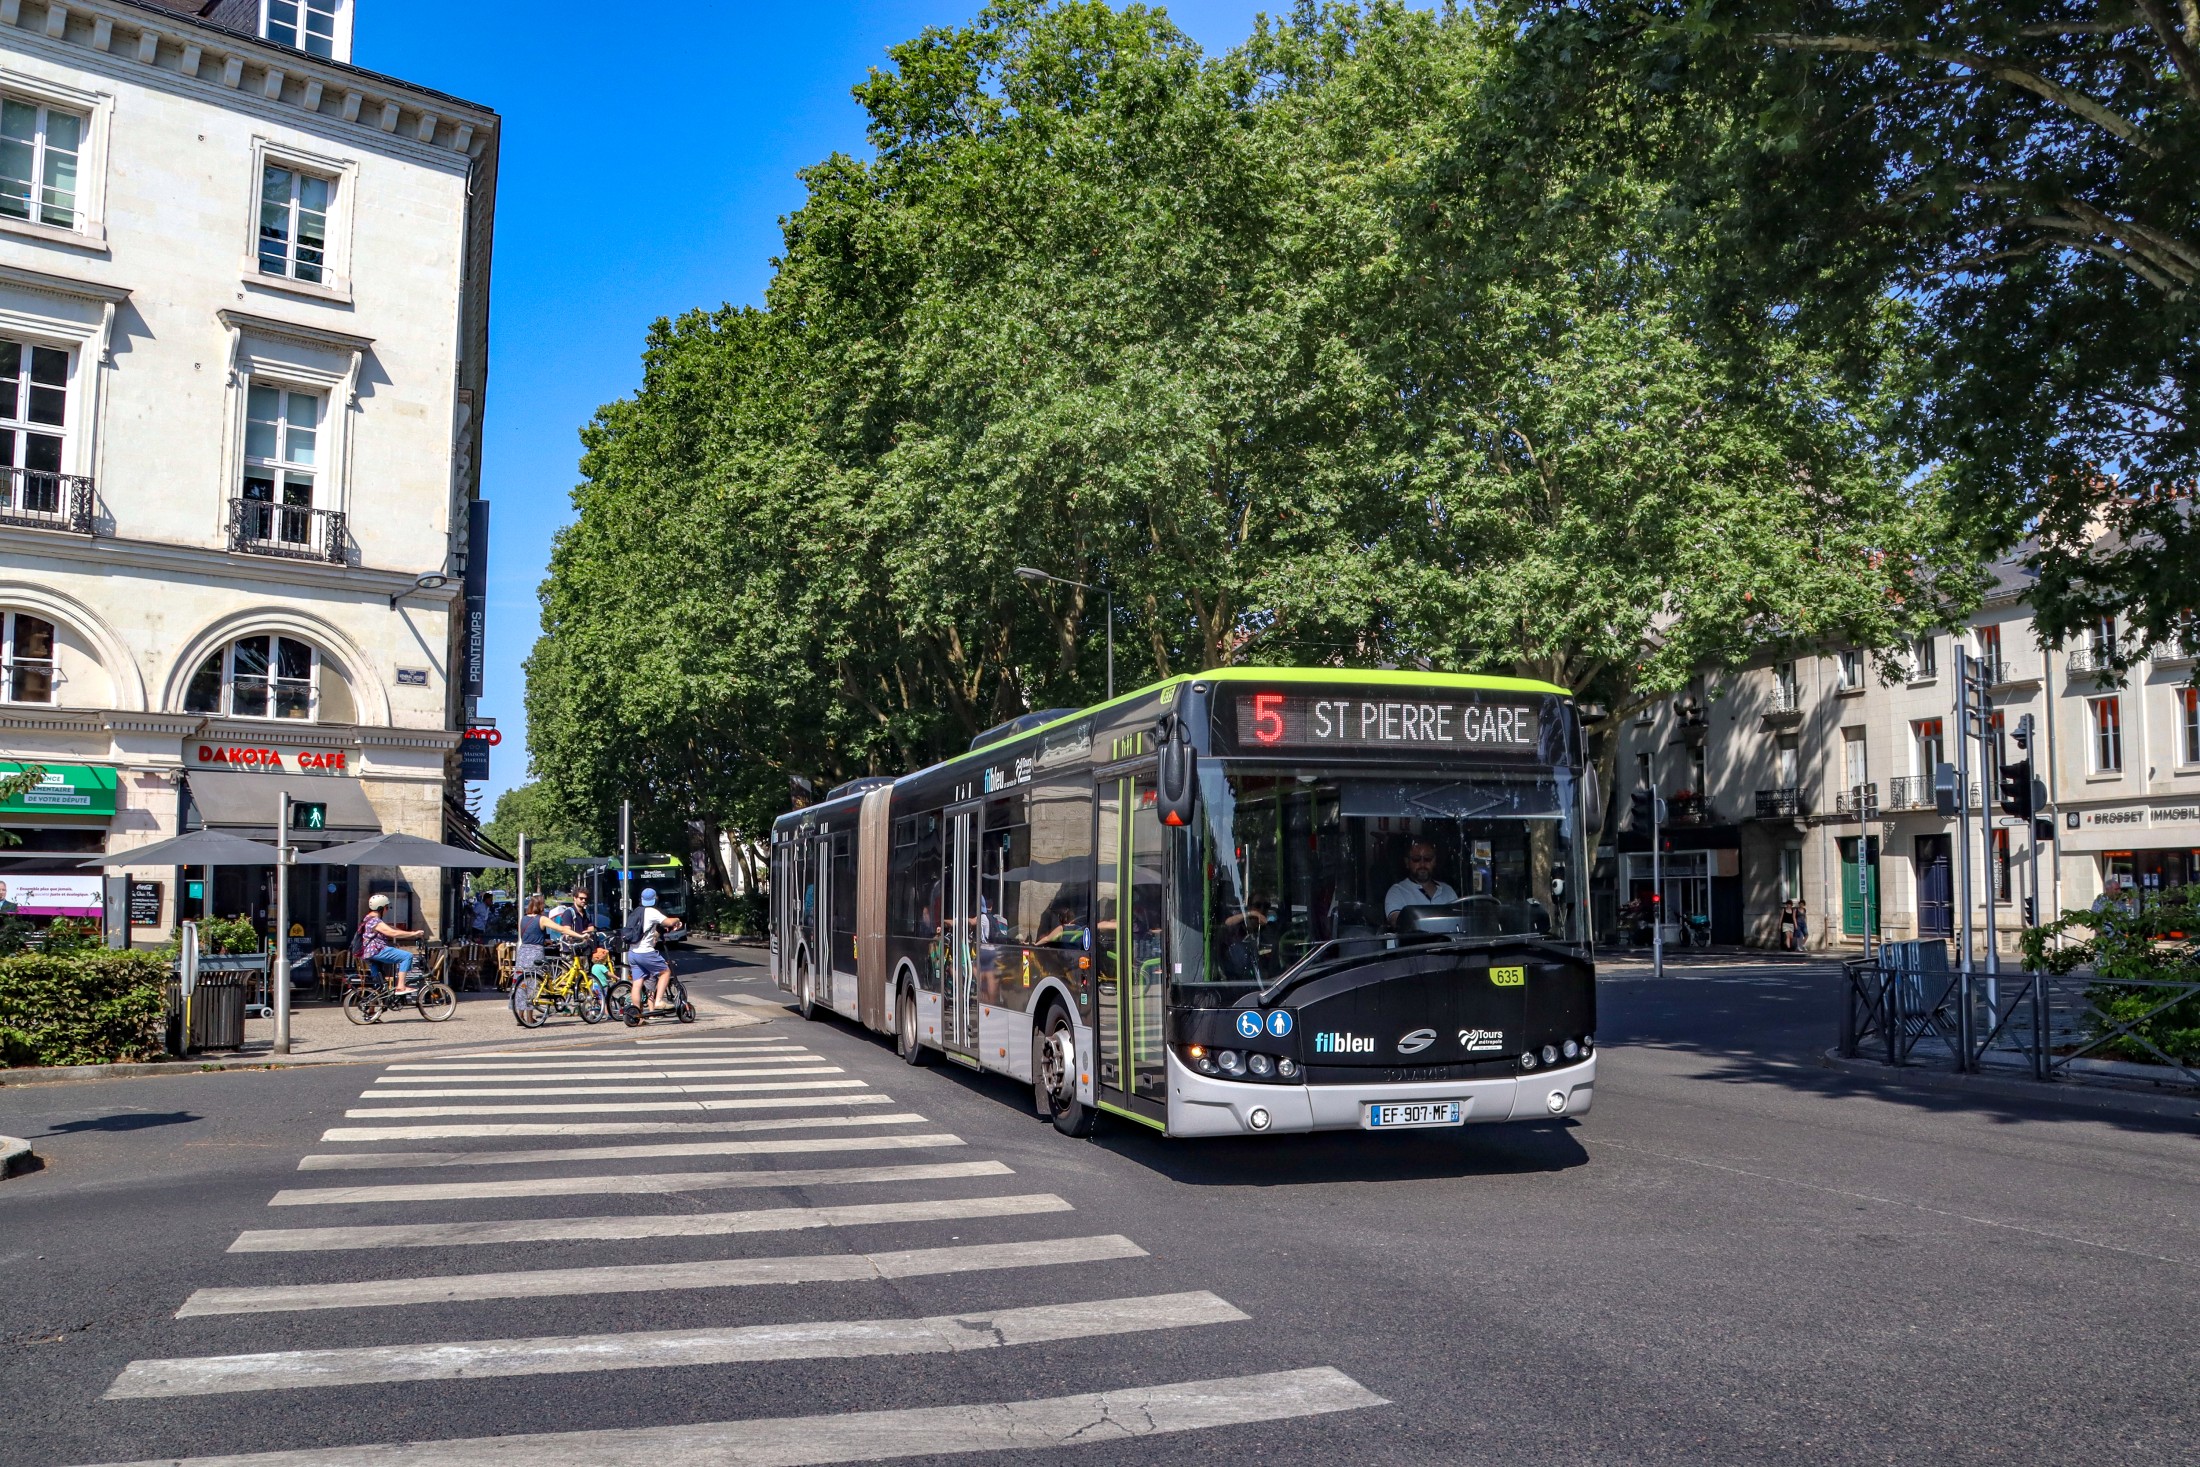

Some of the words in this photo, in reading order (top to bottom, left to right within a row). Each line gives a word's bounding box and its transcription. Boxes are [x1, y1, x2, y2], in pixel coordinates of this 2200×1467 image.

[470, 611, 482, 682] PRINTEMPS
[1256, 695, 1283, 742] 5
[1315, 701, 1349, 738] ST
[1361, 702, 1453, 741] PIERRE
[1464, 706, 1530, 743] GARE
[198, 745, 283, 766] DAKOTA
[297, 750, 346, 769] CAFÉ
[62, 796, 88, 804] DÉPUTÉ
[2094, 810, 2144, 824] BROSSET
[1497, 969, 1519, 983] 635
[1315, 1032, 1375, 1053] filbleu
[1477, 1029, 1503, 1039] Tours
[1382, 1104, 1449, 1123] EF-907-MF
